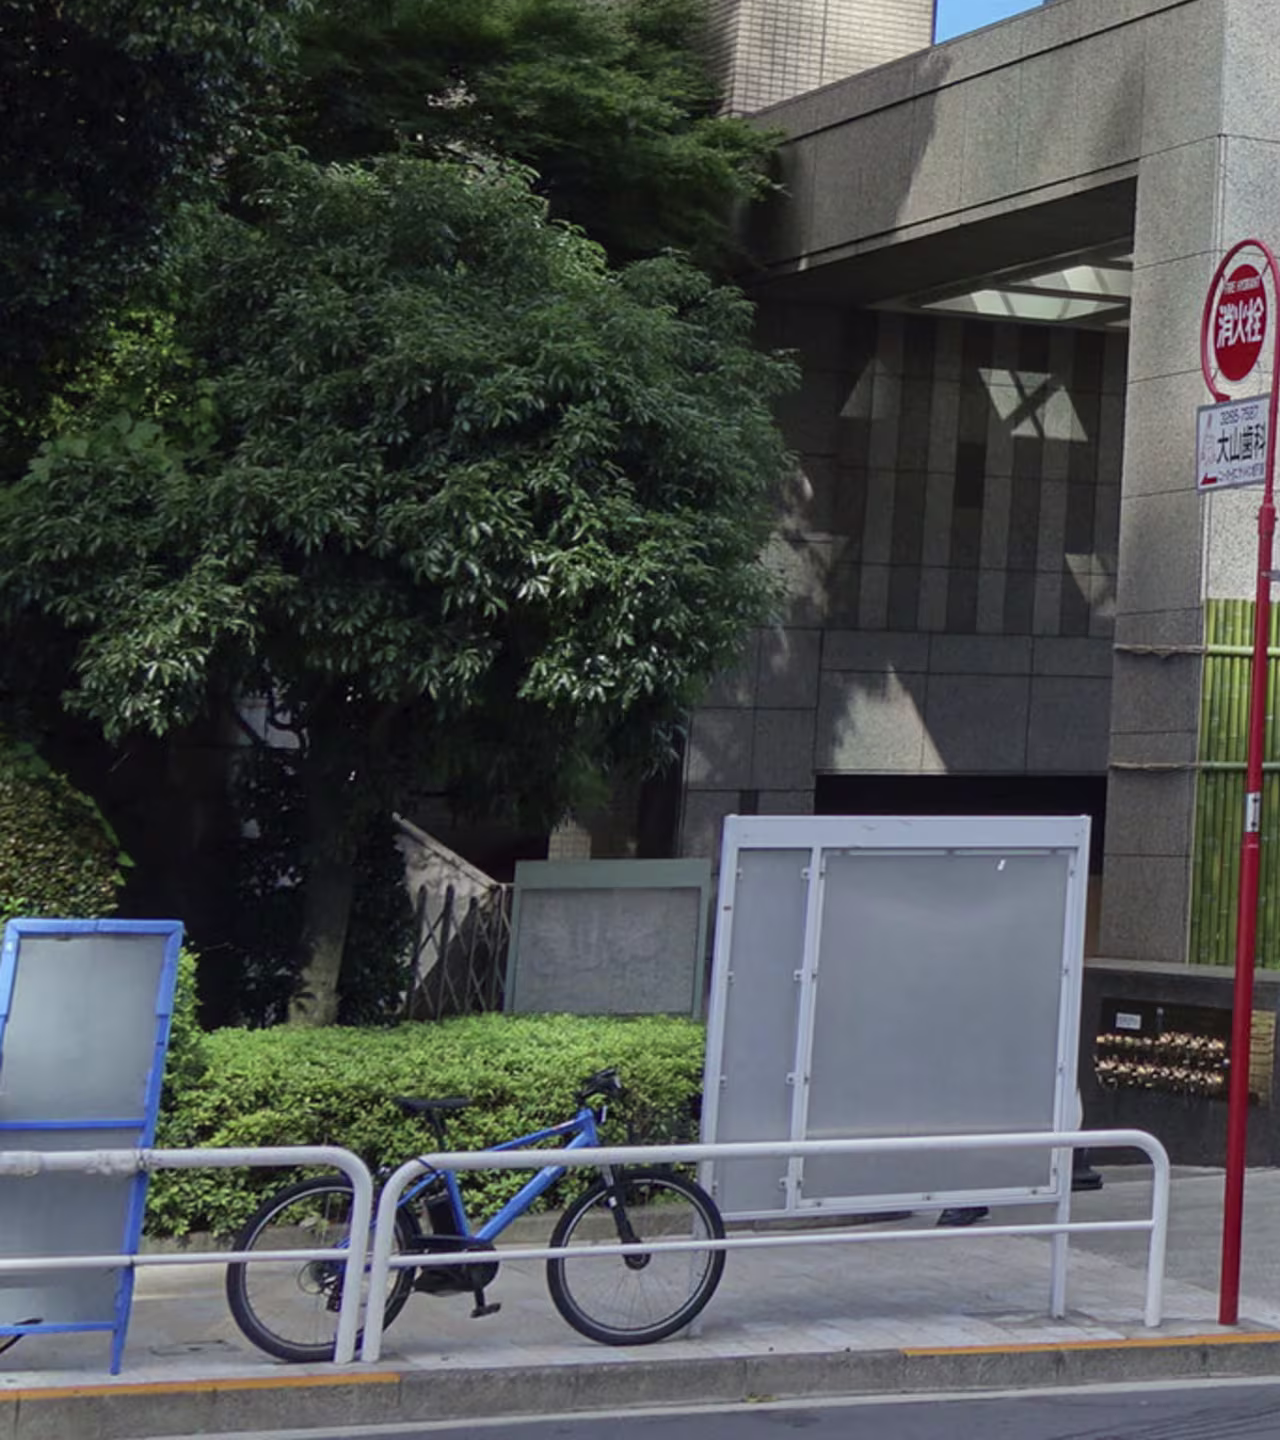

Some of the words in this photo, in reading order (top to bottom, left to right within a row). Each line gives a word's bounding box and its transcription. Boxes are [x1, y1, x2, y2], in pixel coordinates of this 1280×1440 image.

[1216, 296, 1264, 348] 消火栓
[1216, 424, 1266, 464] 大山歯科
